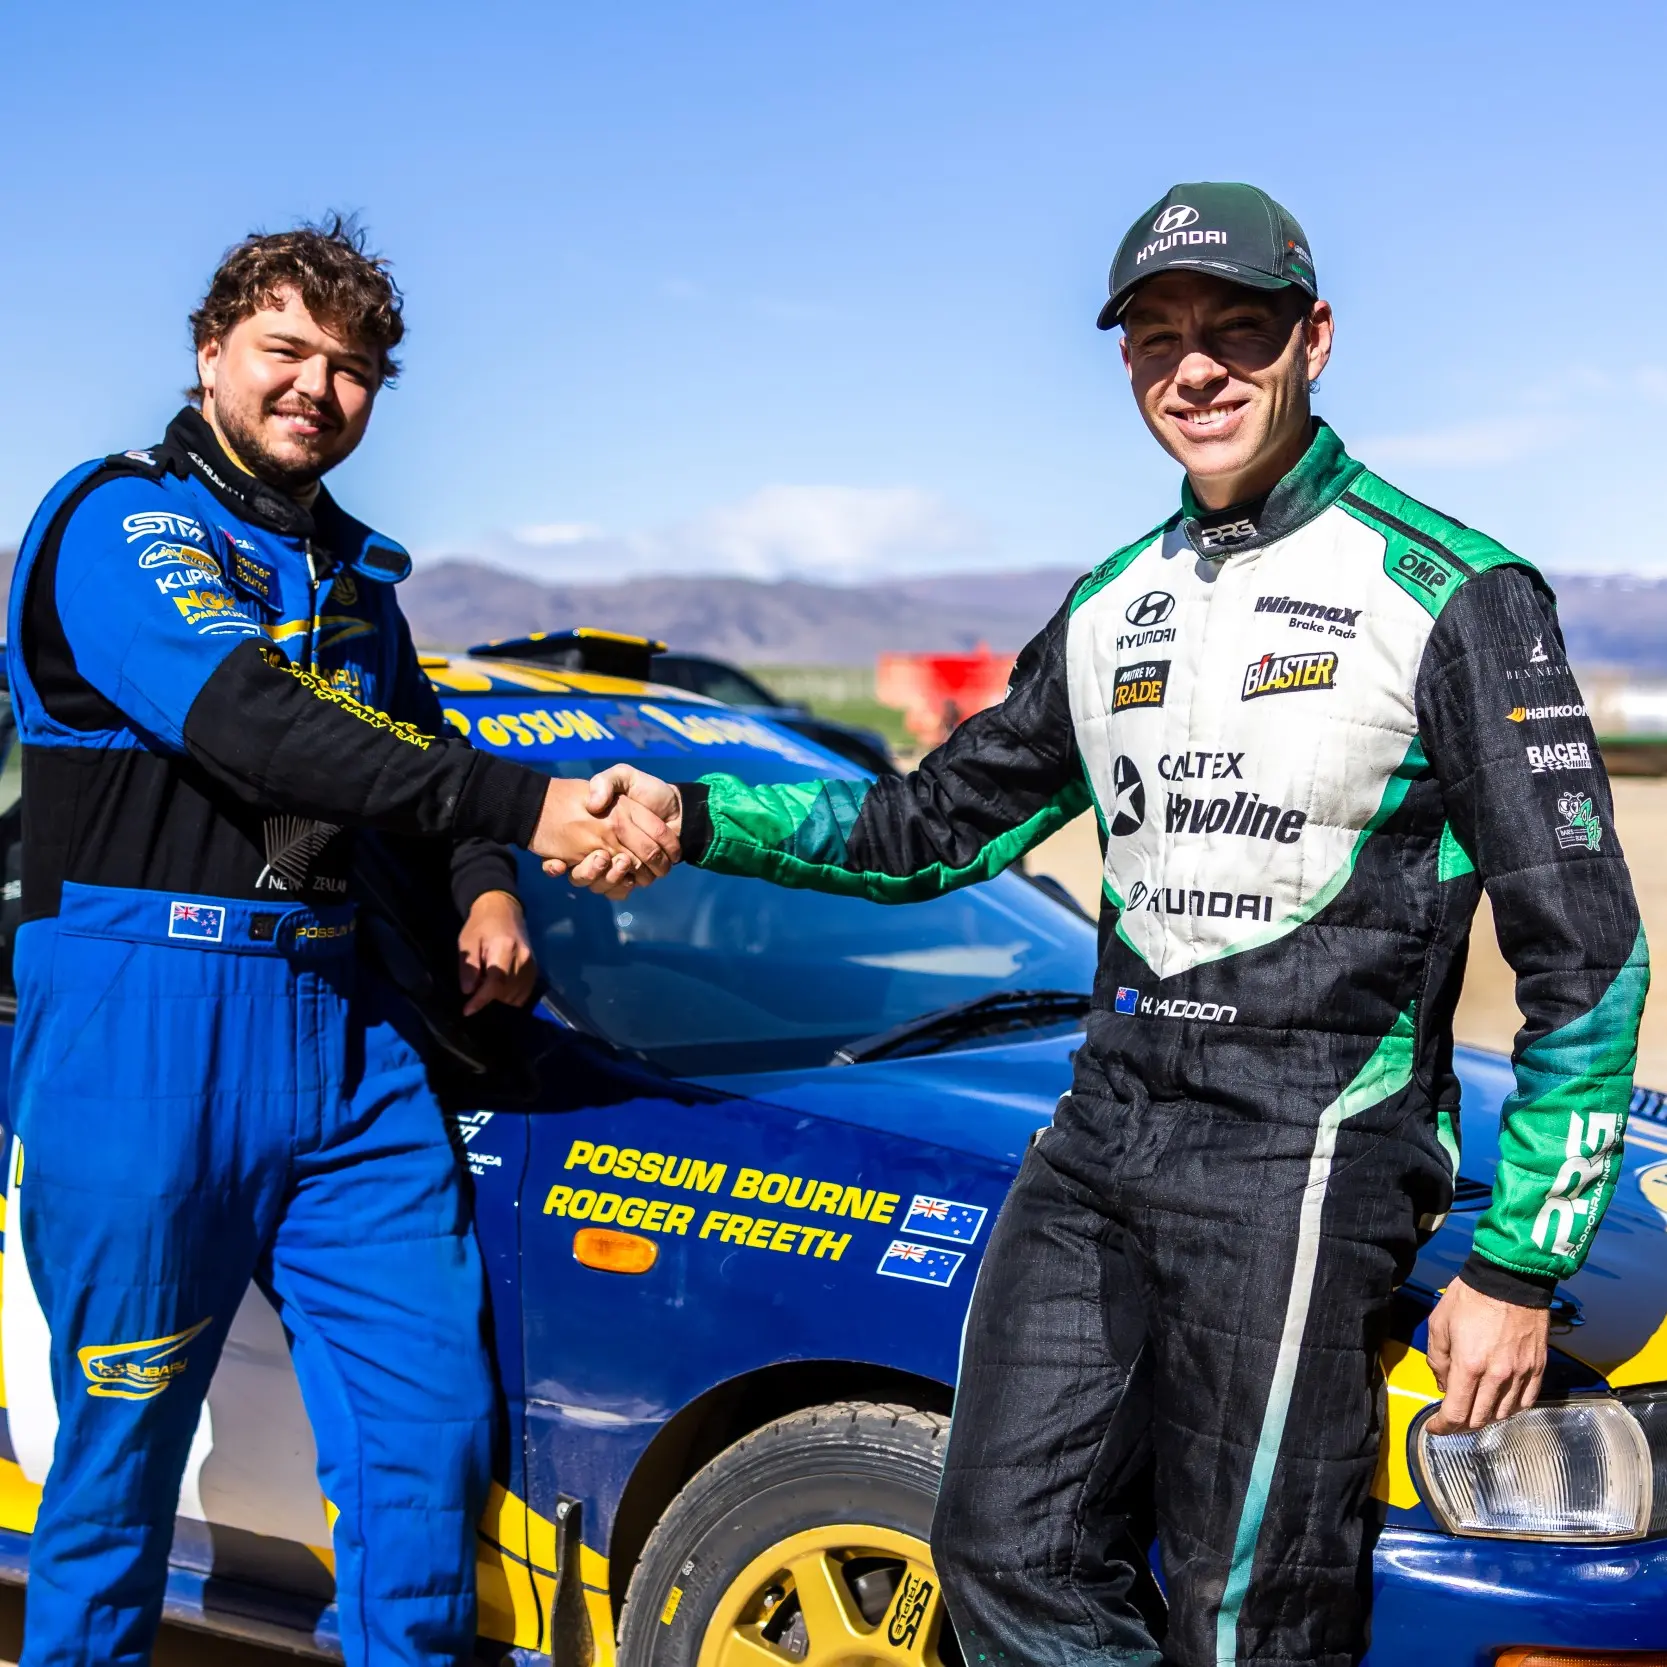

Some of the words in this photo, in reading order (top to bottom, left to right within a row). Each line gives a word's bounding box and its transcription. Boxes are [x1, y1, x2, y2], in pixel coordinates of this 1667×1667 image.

[1136, 231, 1227, 265] HYUNDAI
[1202, 519, 1258, 547] PRG
[236, 553, 271, 579] pencer
[1399, 553, 1447, 589] OMP
[1254, 596, 1363, 627] Winmax
[1116, 628, 1177, 651] HYUNDAI
[1289, 617, 1324, 633] Brake
[1328, 627, 1357, 639] Pads
[1119, 667, 1144, 683] MITRE
[1145, 666, 1157, 678] 10
[389, 724, 430, 750] TEAM
[1157, 751, 1246, 781] CALTEX
[1526, 742, 1591, 765] RACER
[564, 1140, 727, 1194] POSSUM
[731, 1168, 901, 1225] BOURNE
[1531, 1110, 1618, 1257] PRG
[543, 1184, 695, 1236] RODGER
[698, 1211, 852, 1261] FREETH
